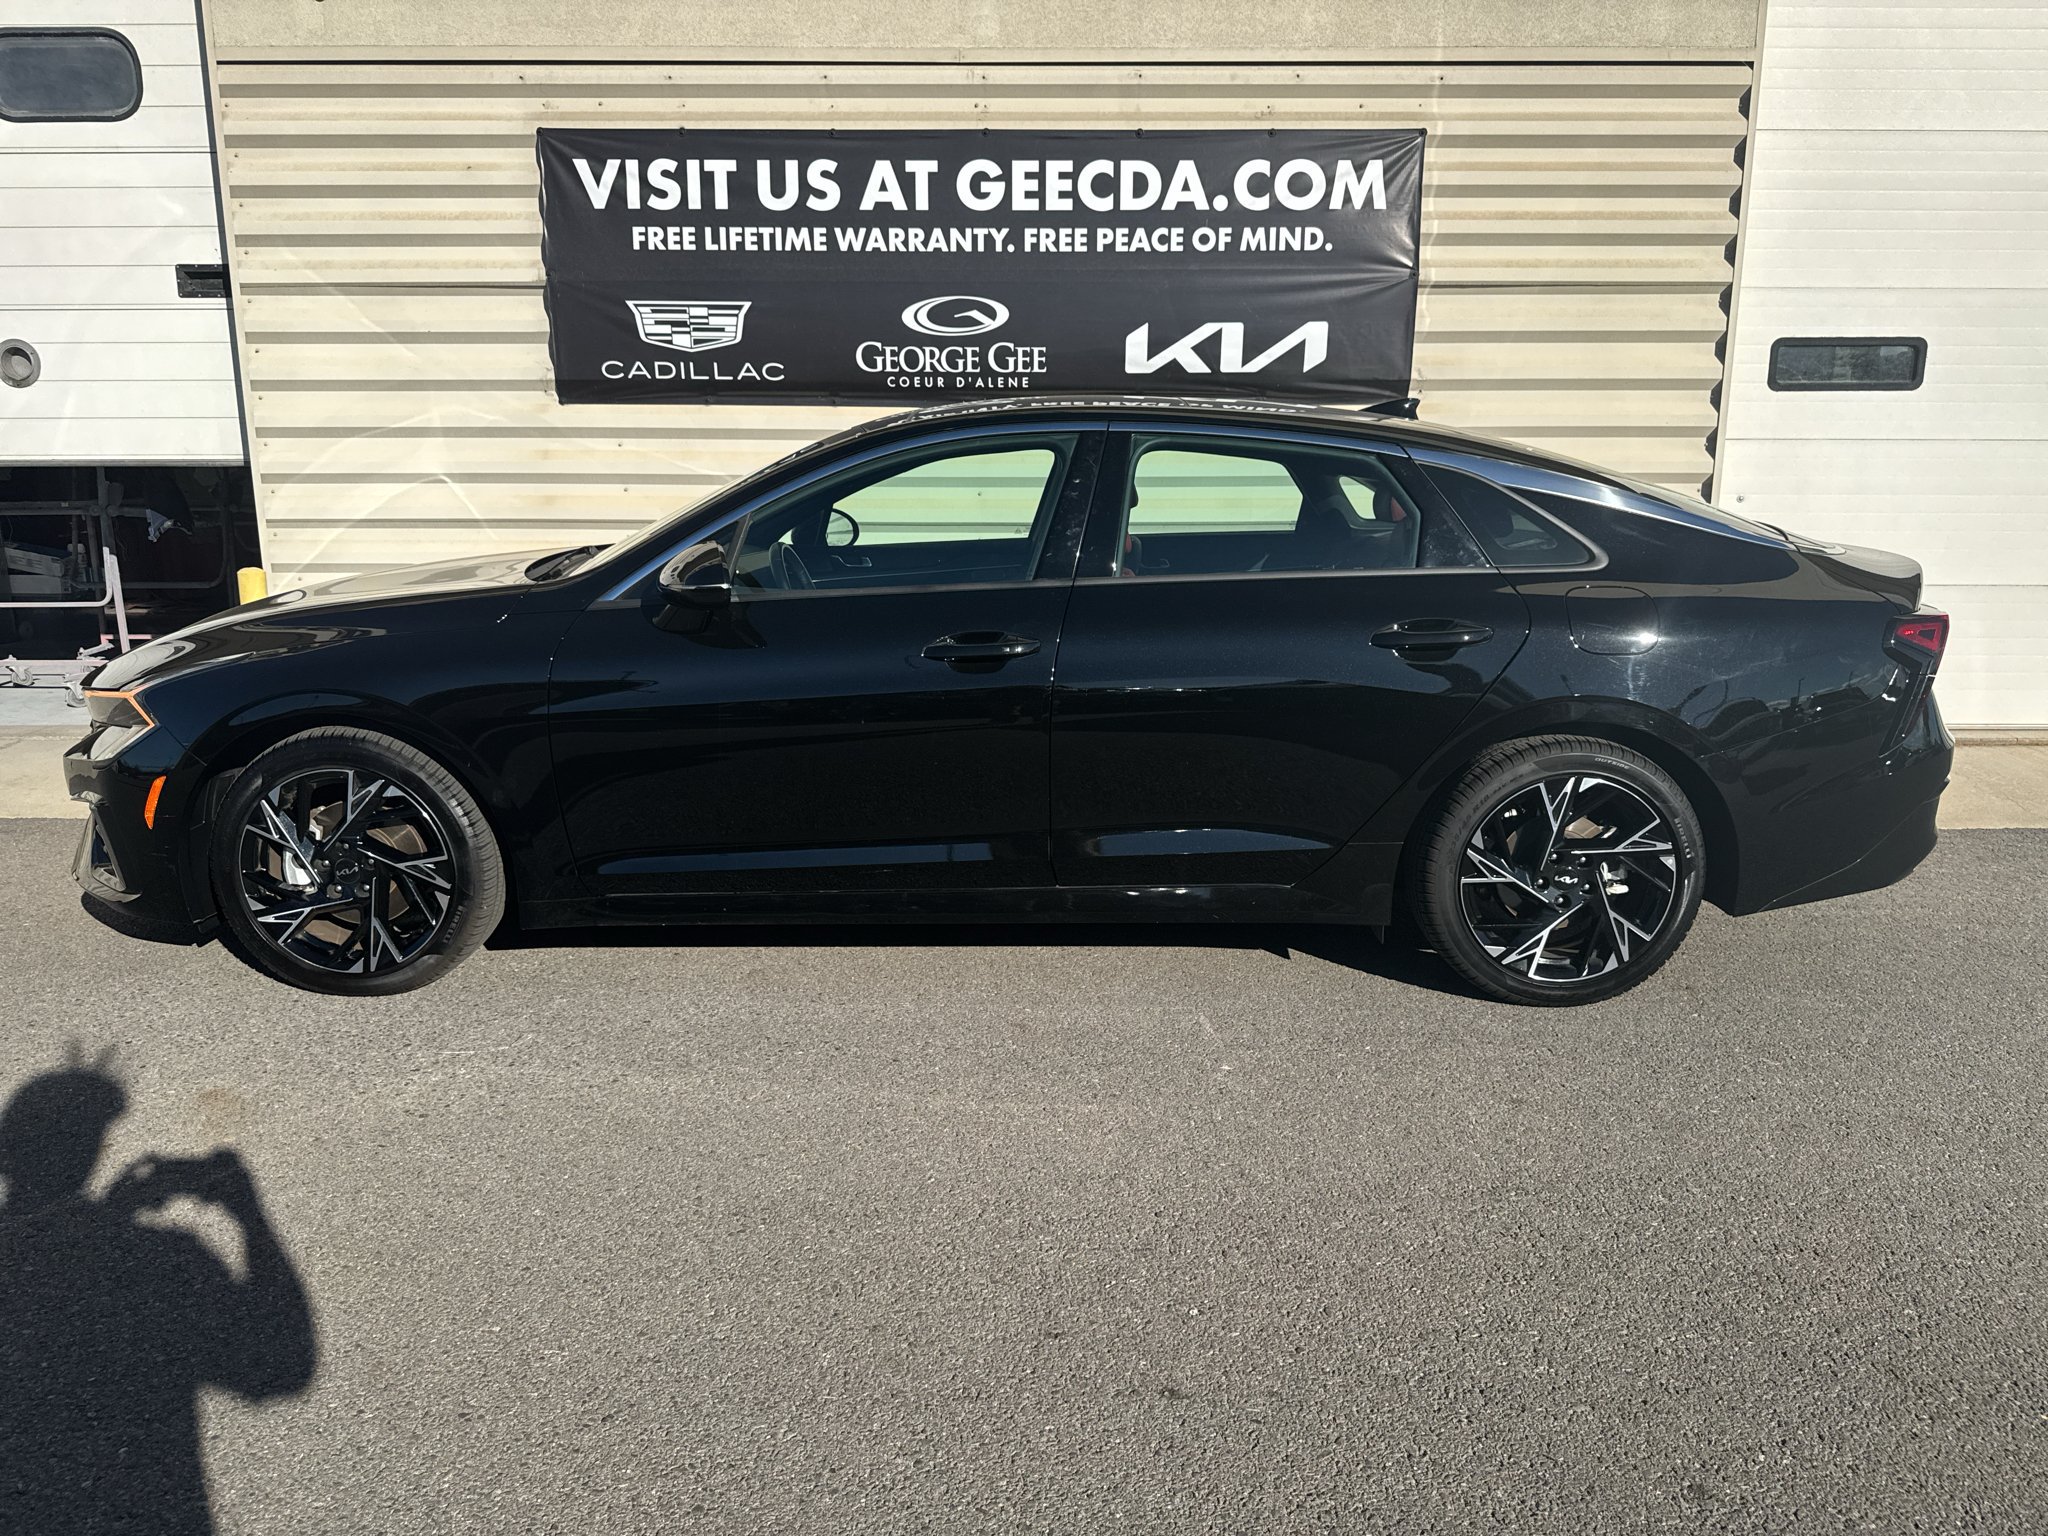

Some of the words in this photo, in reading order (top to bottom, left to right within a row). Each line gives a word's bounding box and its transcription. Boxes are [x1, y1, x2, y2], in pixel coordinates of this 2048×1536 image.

[572, 158, 738, 210] VISIT
[757, 158, 841, 212] US
[859, 159, 939, 211] AT
[956, 158, 1388, 212] GEECDA.COM
[631, 226, 697, 251] FREE
[704, 226, 828, 252] LIFETIME
[833, 227, 1015, 253] WARRANTY.
[1024, 227, 1088, 253] FREE
[1096, 227, 1185, 253] PEACE
[1191, 226, 1233, 252] OF
[1239, 226, 1334, 252] MIND.
[601, 360, 785, 381] CADILLAC
[855, 341, 981, 373] GEORGE
[987, 341, 1047, 373] GEE
[886, 376, 945, 388] COEUR
[956, 376, 1029, 388] D'ALENE
